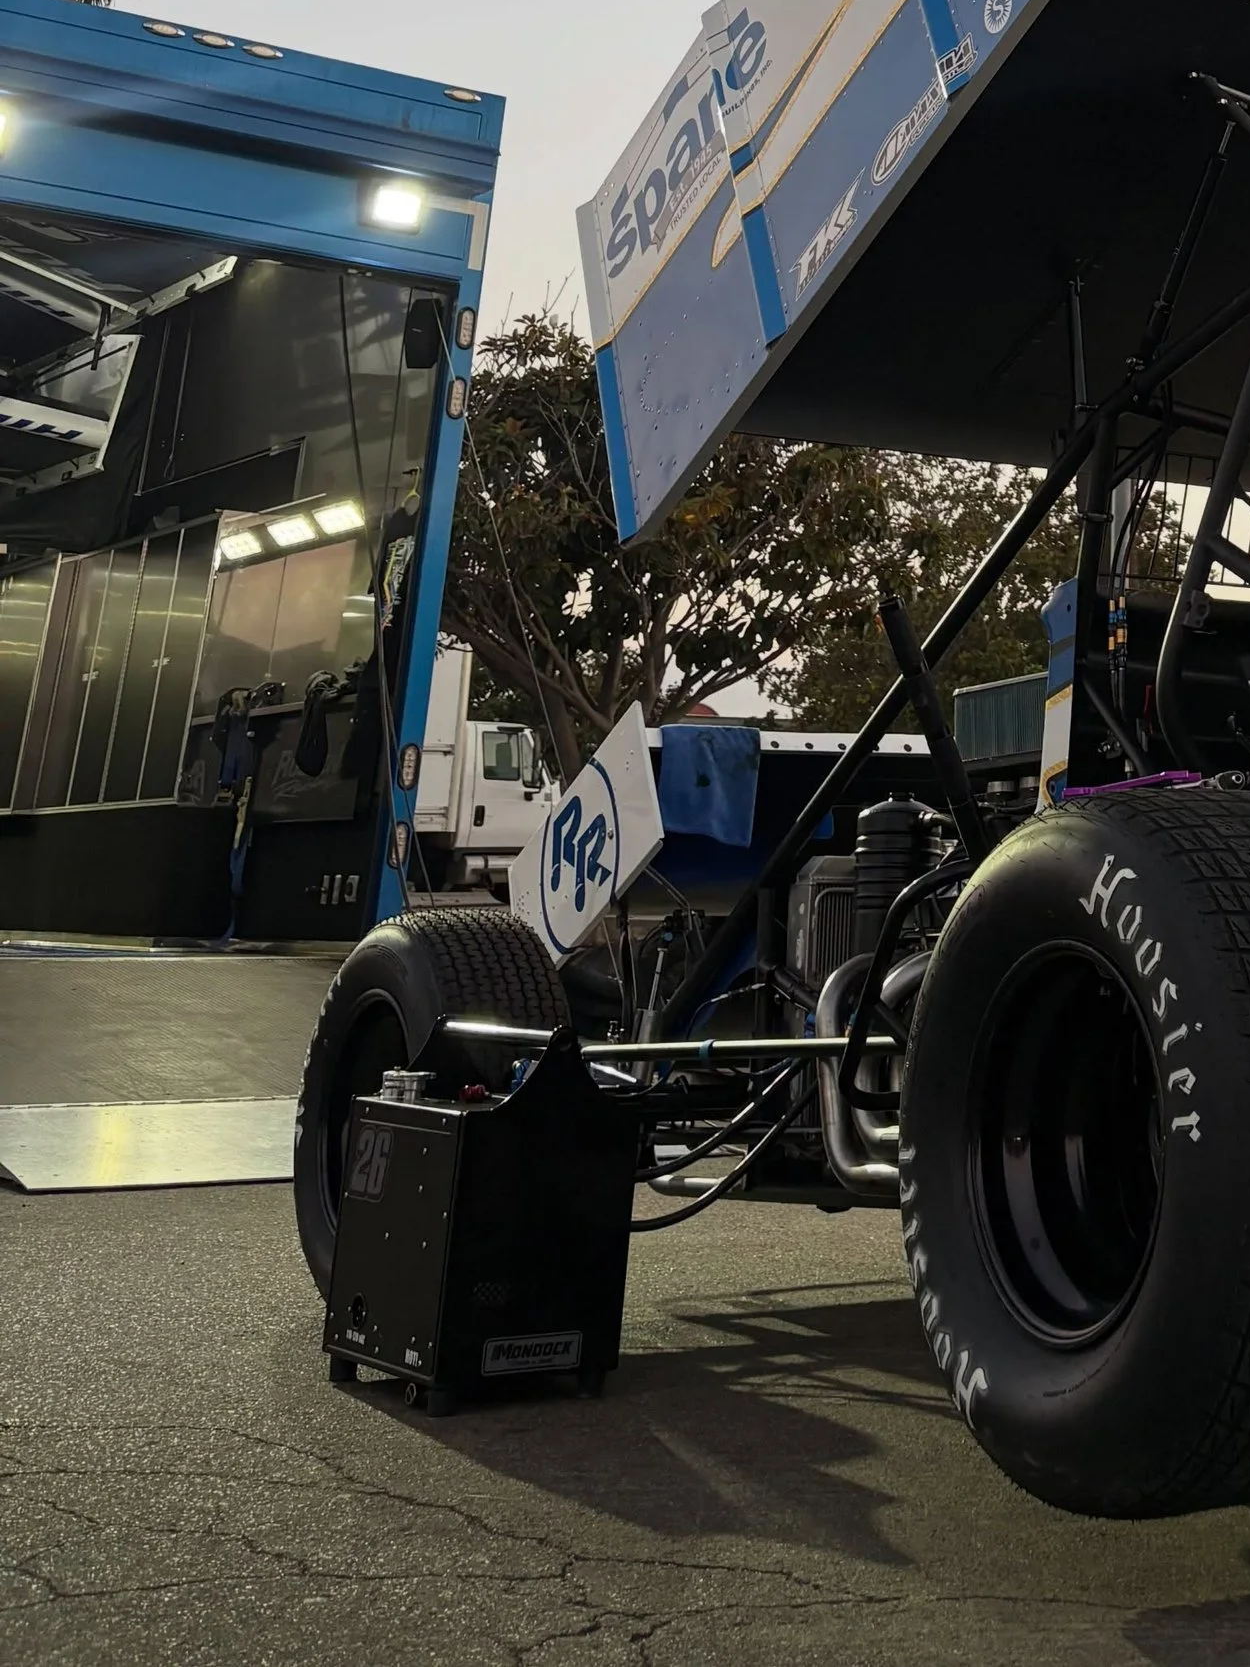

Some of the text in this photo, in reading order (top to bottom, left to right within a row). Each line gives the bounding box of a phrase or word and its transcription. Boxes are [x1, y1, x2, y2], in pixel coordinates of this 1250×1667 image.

[669, 155, 722, 229] TRUSTED LOCAL
[1078, 853, 1204, 1143] Hoosier
[350, 1126, 394, 1202] 26
